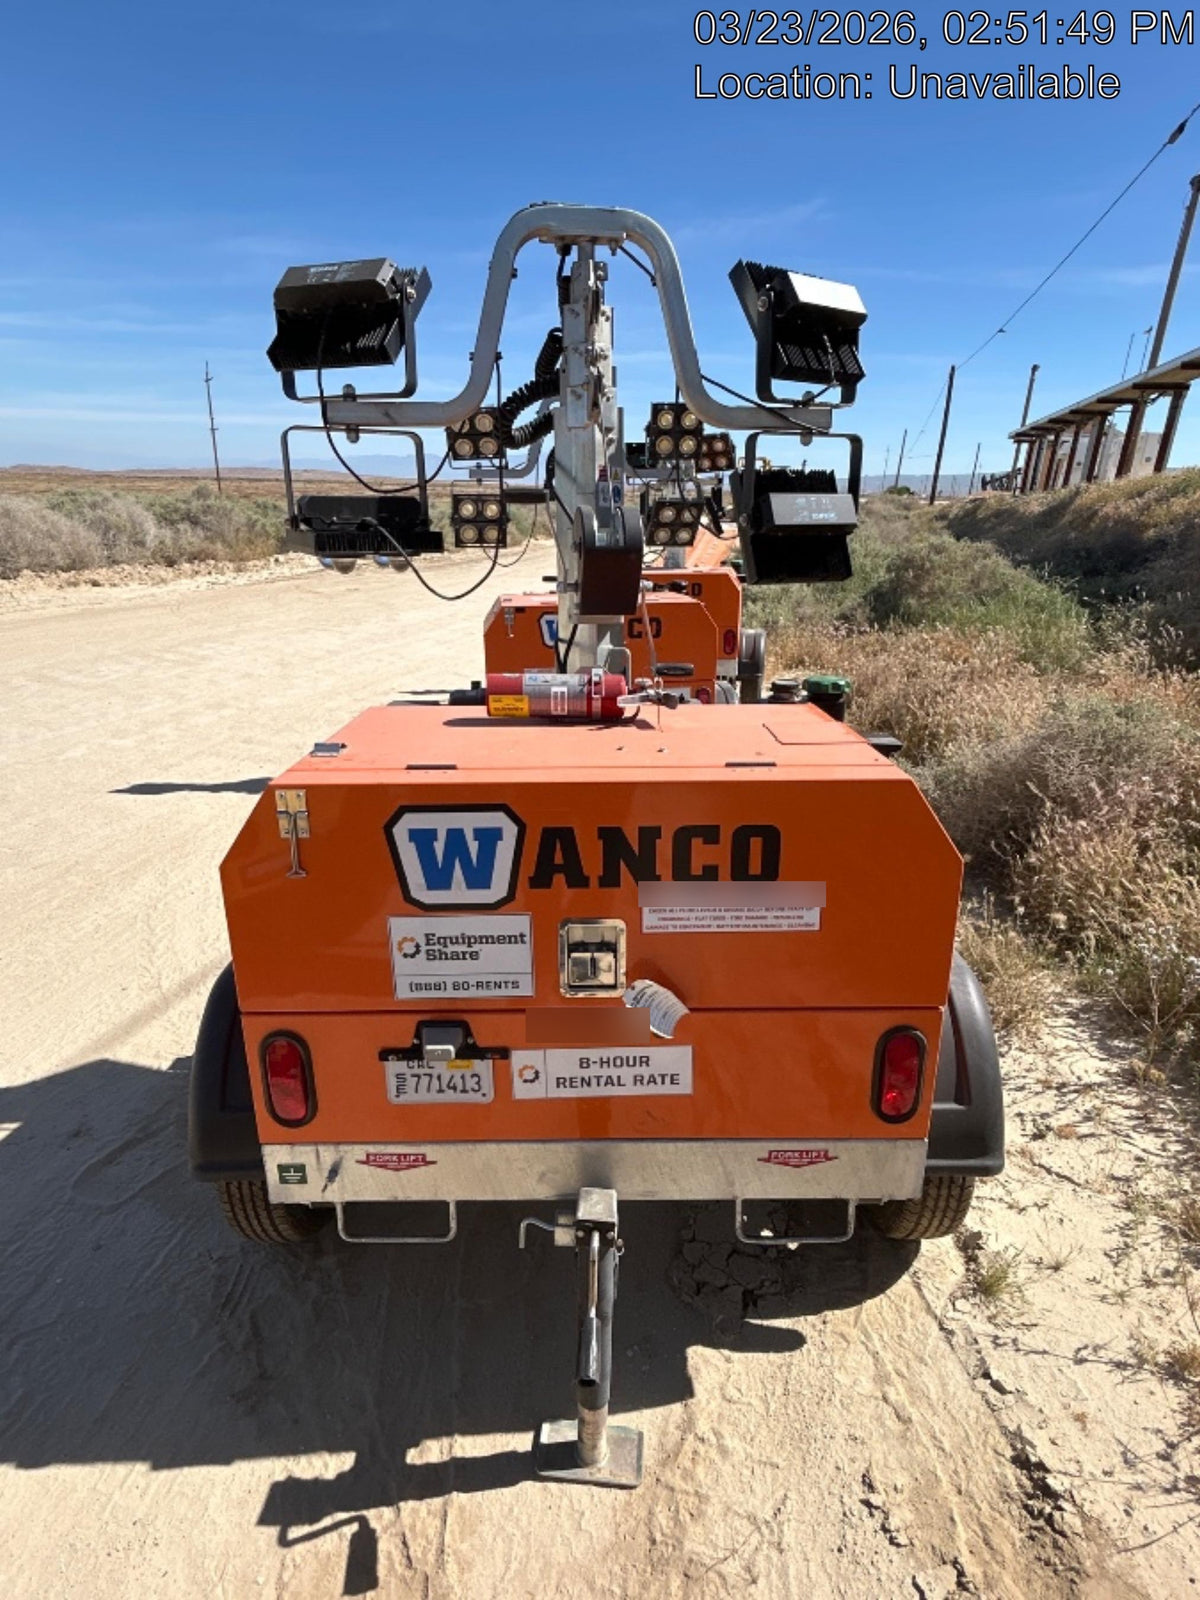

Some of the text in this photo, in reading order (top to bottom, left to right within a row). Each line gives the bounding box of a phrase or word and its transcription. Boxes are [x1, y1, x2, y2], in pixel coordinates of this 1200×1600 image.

[408, 824, 782, 891] WANCO
[424, 932, 527, 948] Equipment
[425, 948, 480, 961] Share
[451, 980, 520, 991] 80-RENTS
[578, 1055, 651, 1069] 8-HOUR
[410, 1073, 482, 1094] 771413
[555, 1073, 681, 1088] RENTAL RATE
[369, 1154, 425, 1162] FORK LIFT
